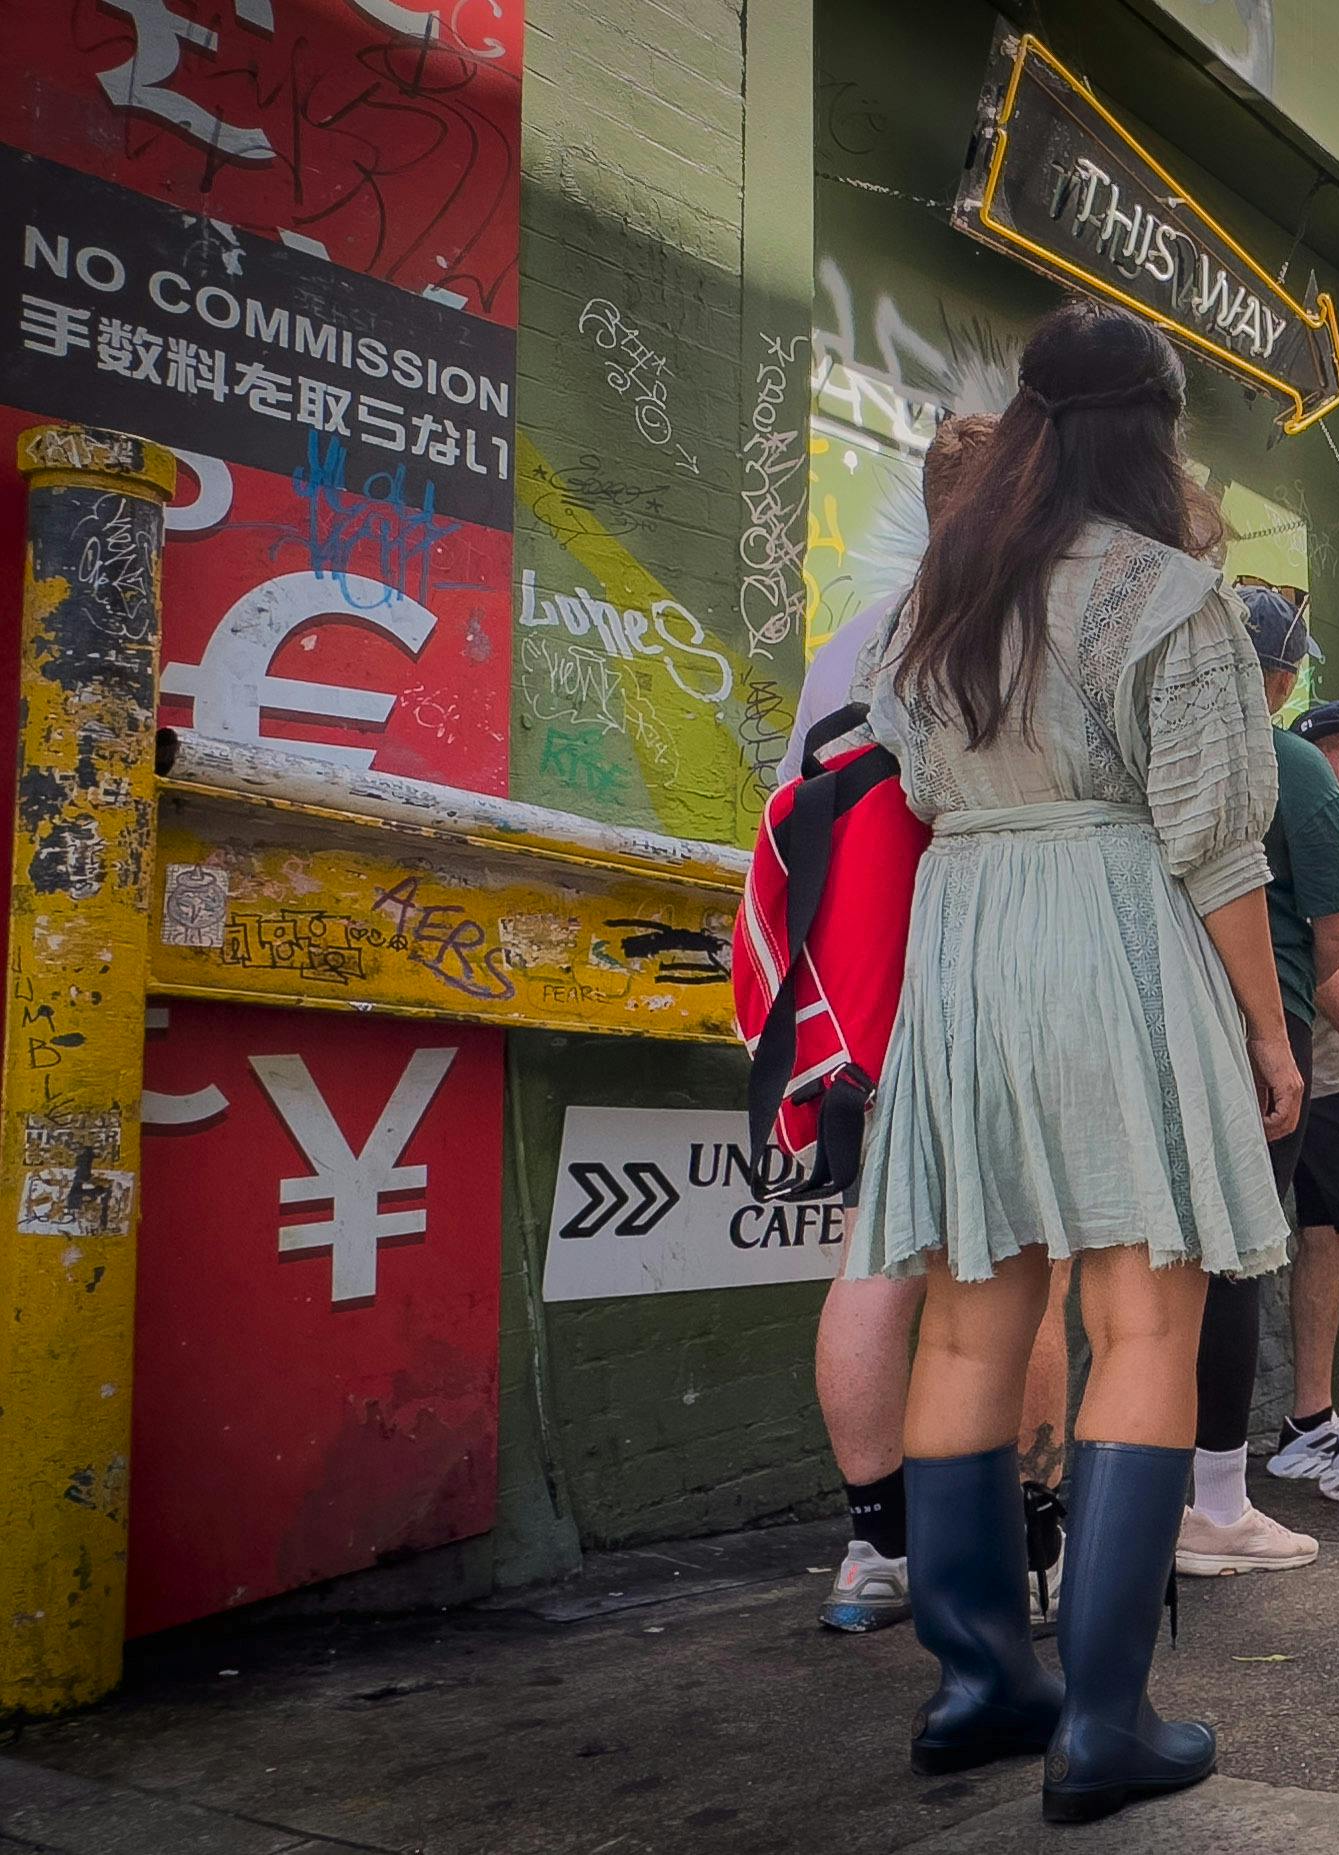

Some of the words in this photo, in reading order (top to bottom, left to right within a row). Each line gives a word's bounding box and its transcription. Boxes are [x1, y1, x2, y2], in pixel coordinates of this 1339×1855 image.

[24, 224, 126, 293] NO
[148, 270, 509, 418] COMMISSION
[1075, 157, 1176, 283] THIS
[1194, 253, 1288, 359] WAY
[20, 293, 509, 481] 手数料を取らない
[729, 1203, 845, 1249] CAFE
